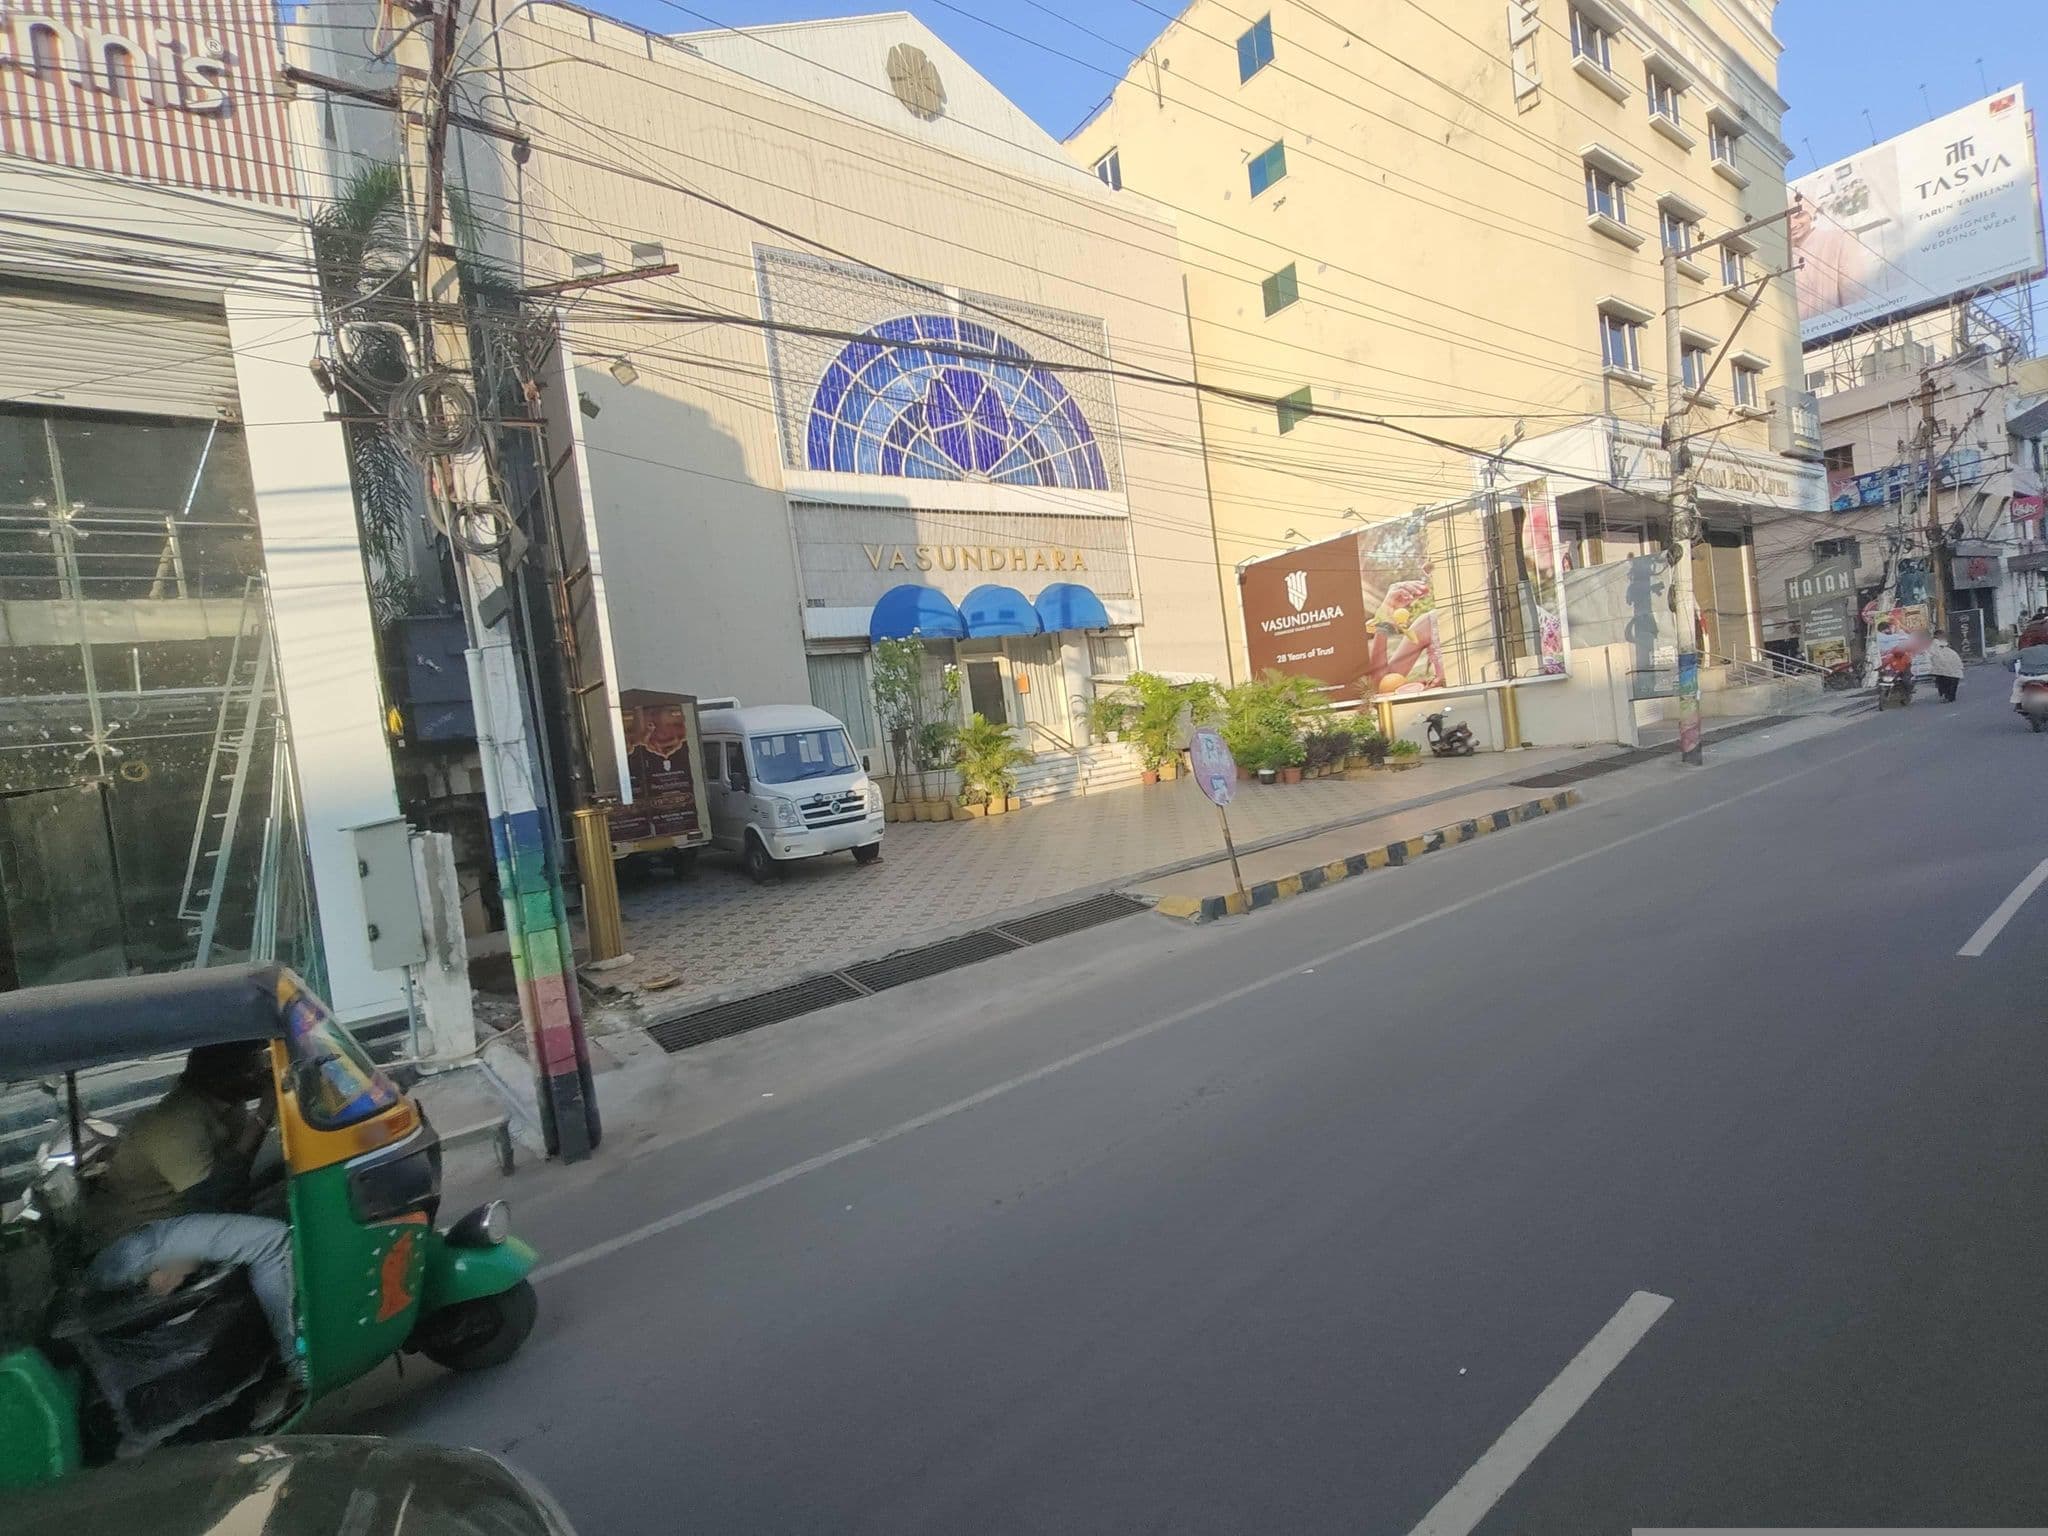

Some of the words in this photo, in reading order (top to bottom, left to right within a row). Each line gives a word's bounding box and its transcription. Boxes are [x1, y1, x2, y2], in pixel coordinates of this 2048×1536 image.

[0, 15, 226, 108] nnis
[1915, 154, 2012, 199] TASVA
[1918, 203, 1954, 221] TARUN
[1937, 211, 1998, 239] DESIGNER
[1920, 229, 1978, 253] WEDDING
[1983, 215, 2018, 232] WEAR
[862, 543, 1089, 572] VASUNDHARA
[1261, 605, 1344, 633] VASUNDHARA
[1288, 652, 1307, 661] Years
[1307, 648, 1316, 658] of
[1316, 646, 1335, 656] Trust
